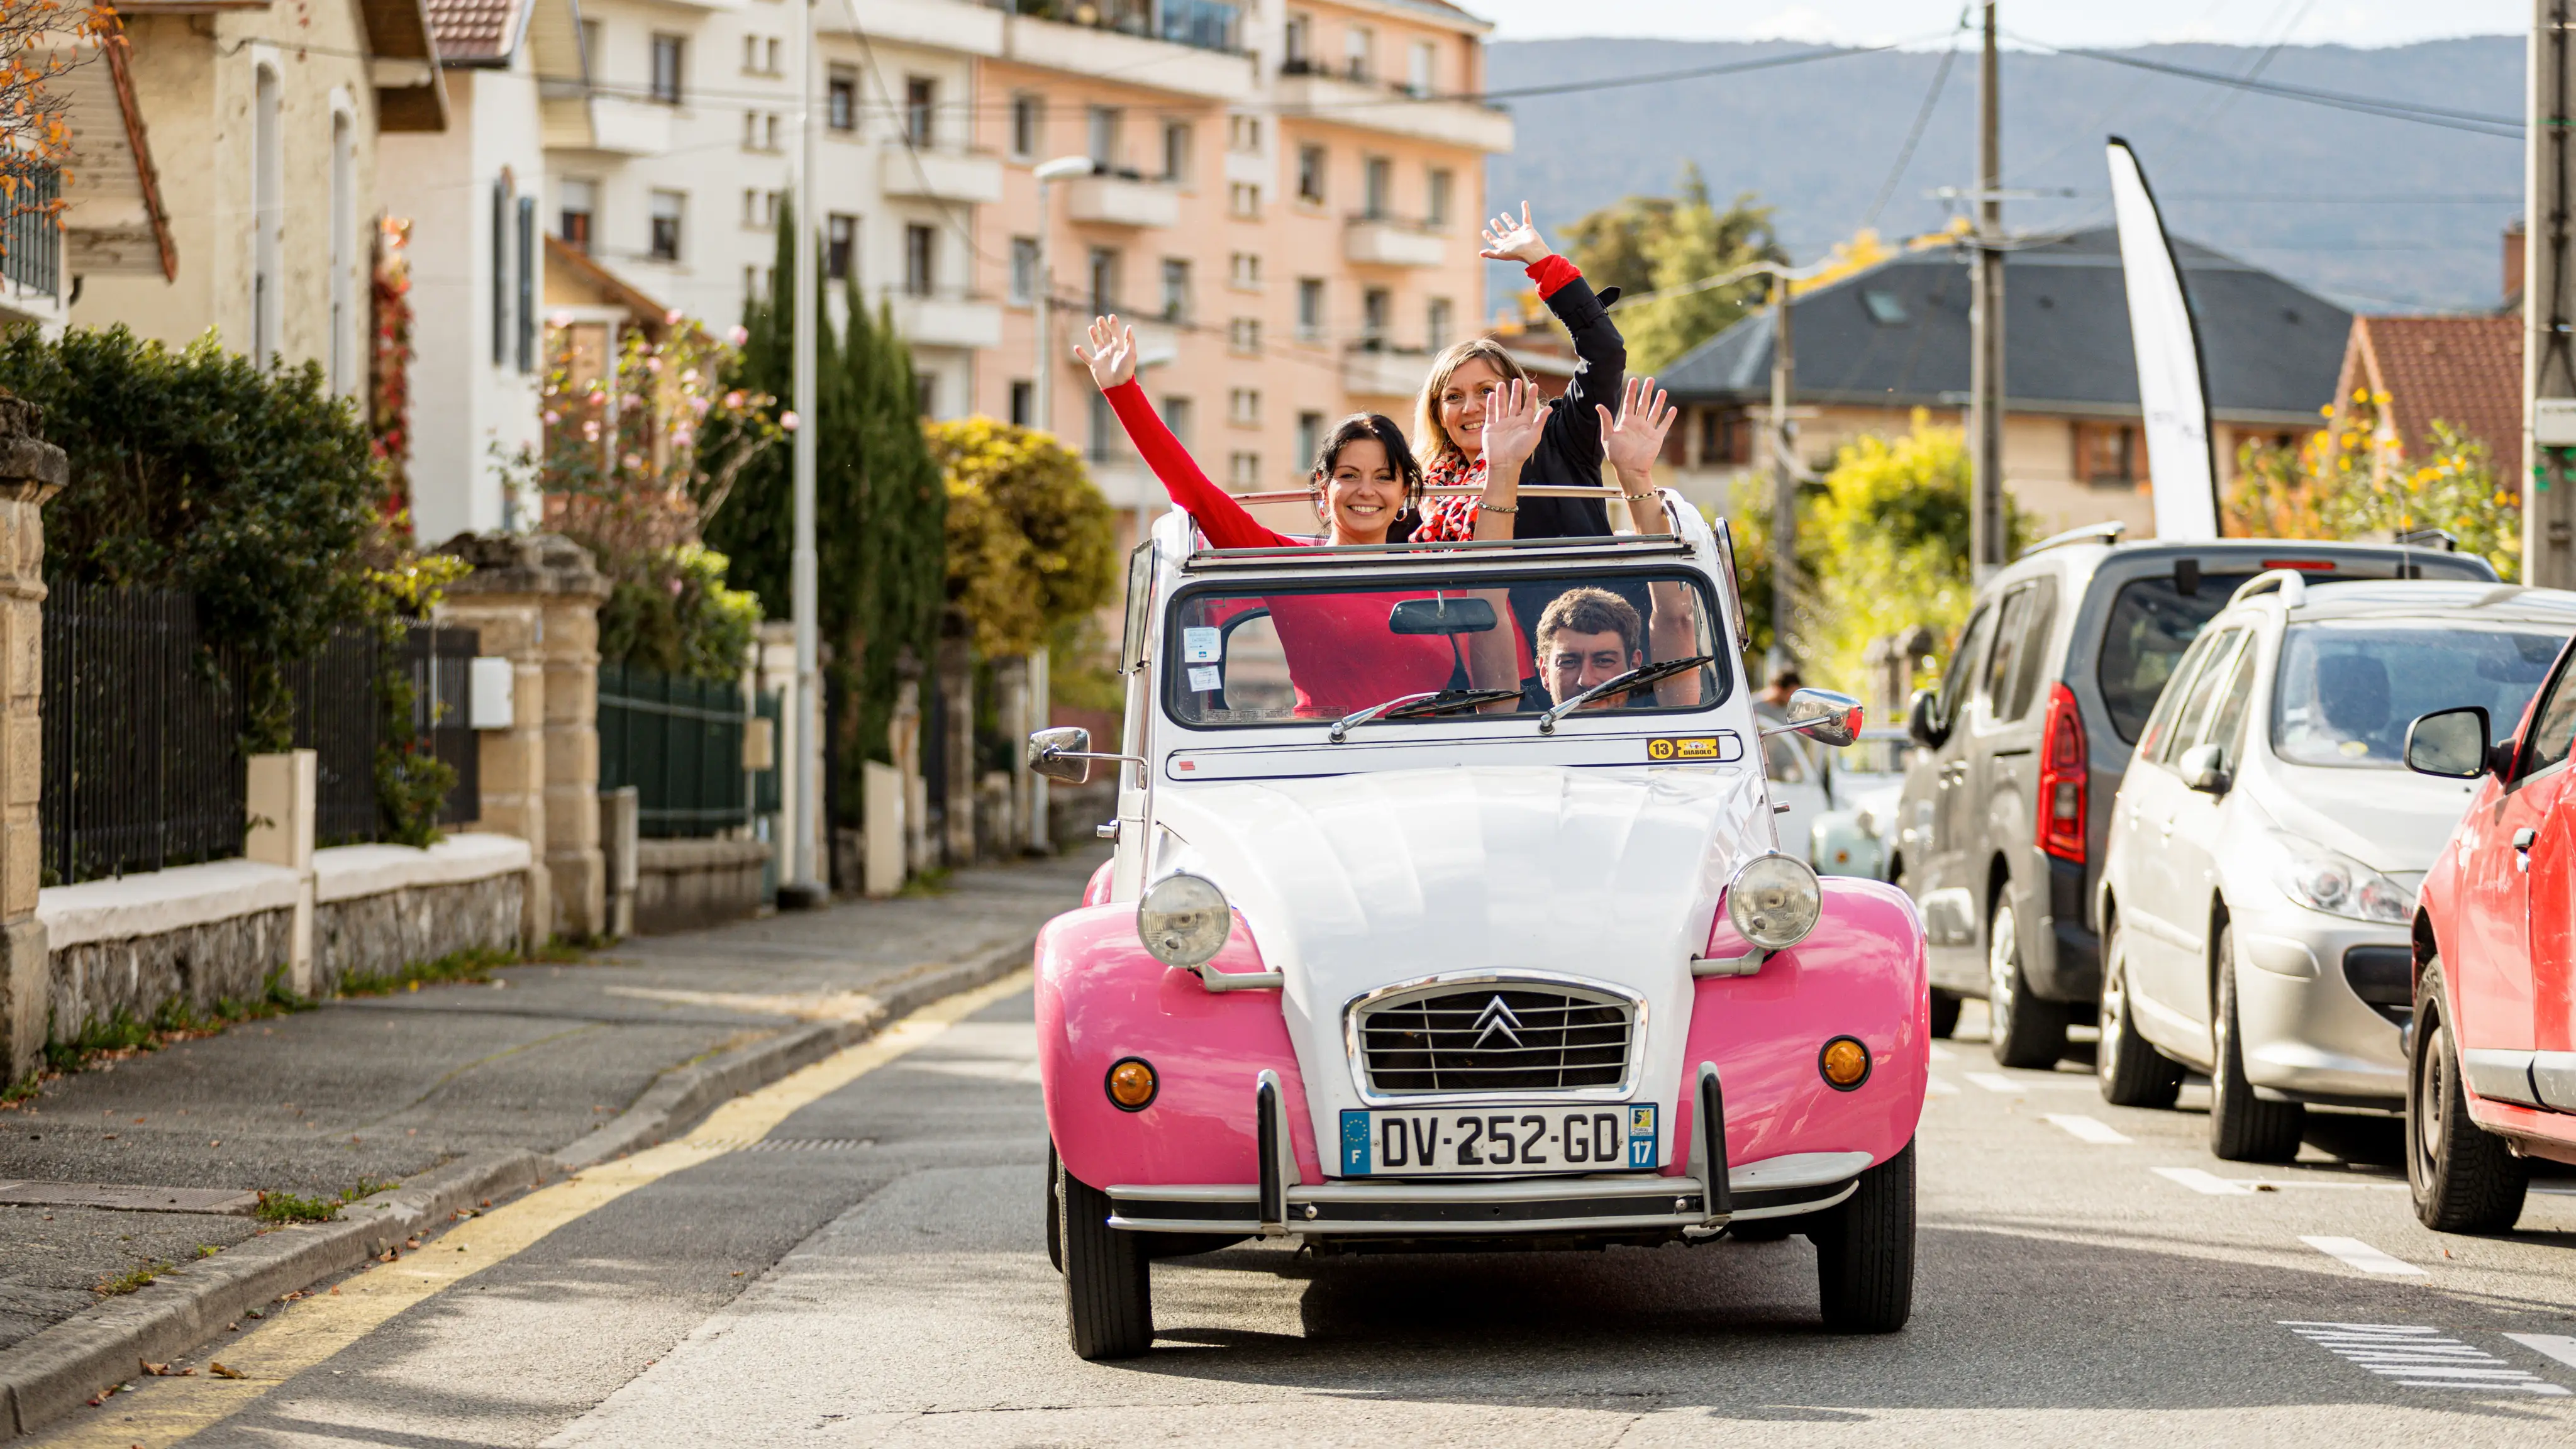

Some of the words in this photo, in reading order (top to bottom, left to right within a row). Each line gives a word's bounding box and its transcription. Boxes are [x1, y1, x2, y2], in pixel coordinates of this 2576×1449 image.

[1653, 743, 1669, 755] 13
[1382, 1113, 1618, 1167] DV-252-GD
[1352, 1150, 1360, 1163] F
[1633, 1141, 1652, 1163] 17
